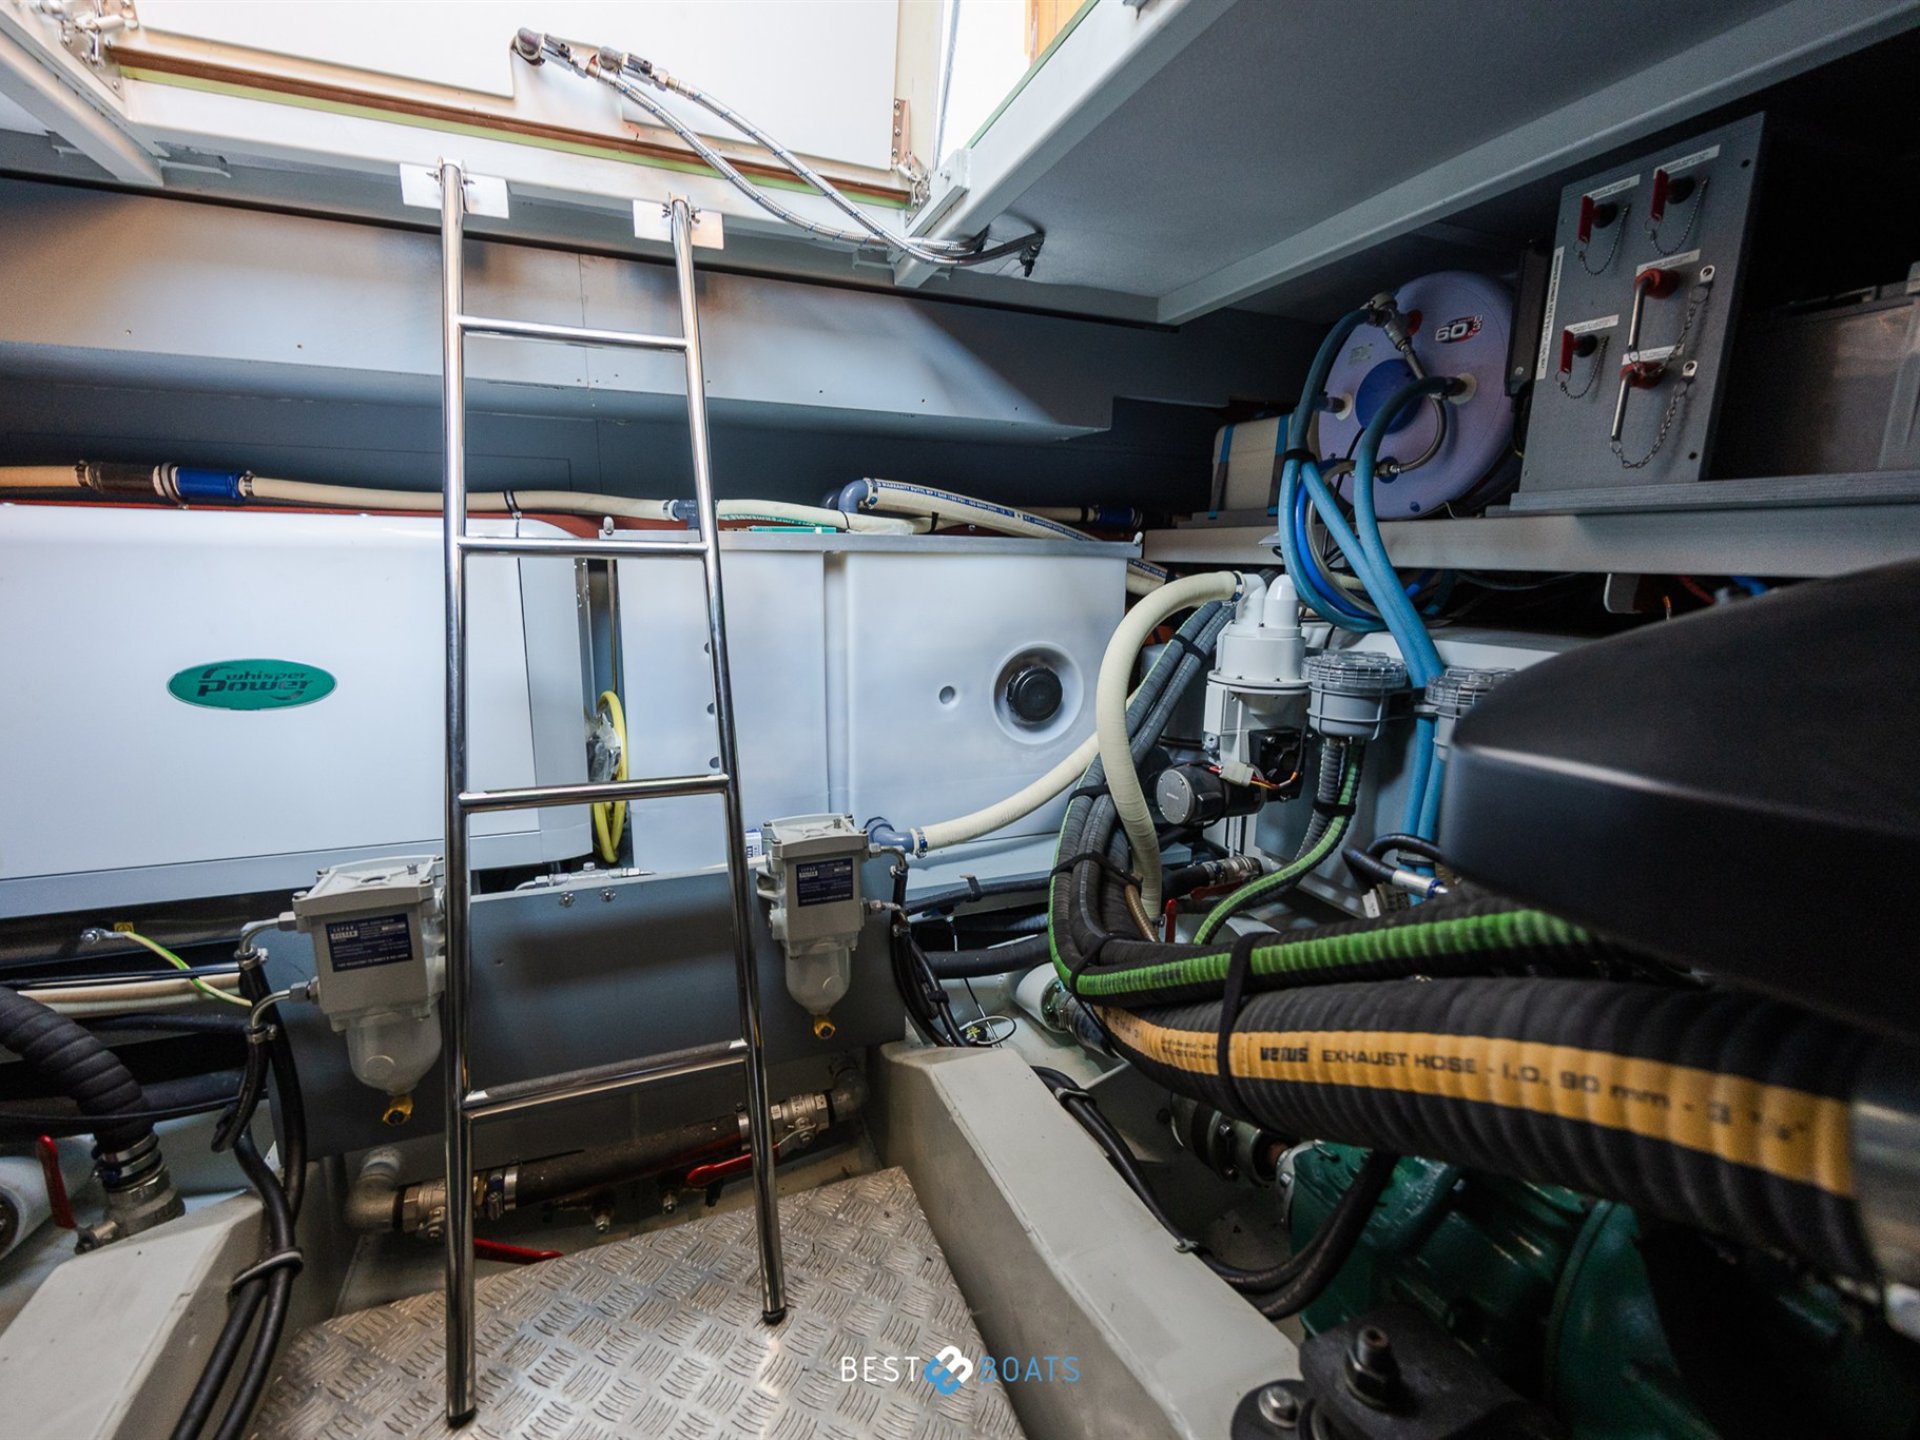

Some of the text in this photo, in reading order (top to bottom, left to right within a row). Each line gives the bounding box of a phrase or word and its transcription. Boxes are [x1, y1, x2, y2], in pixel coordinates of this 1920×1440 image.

[226, 670, 309, 681] whisper
[1322, 1049, 1407, 1067] EXHAUST
[1414, 1054, 1478, 1074] HOSE
[1560, 1071, 1600, 1093] 90
